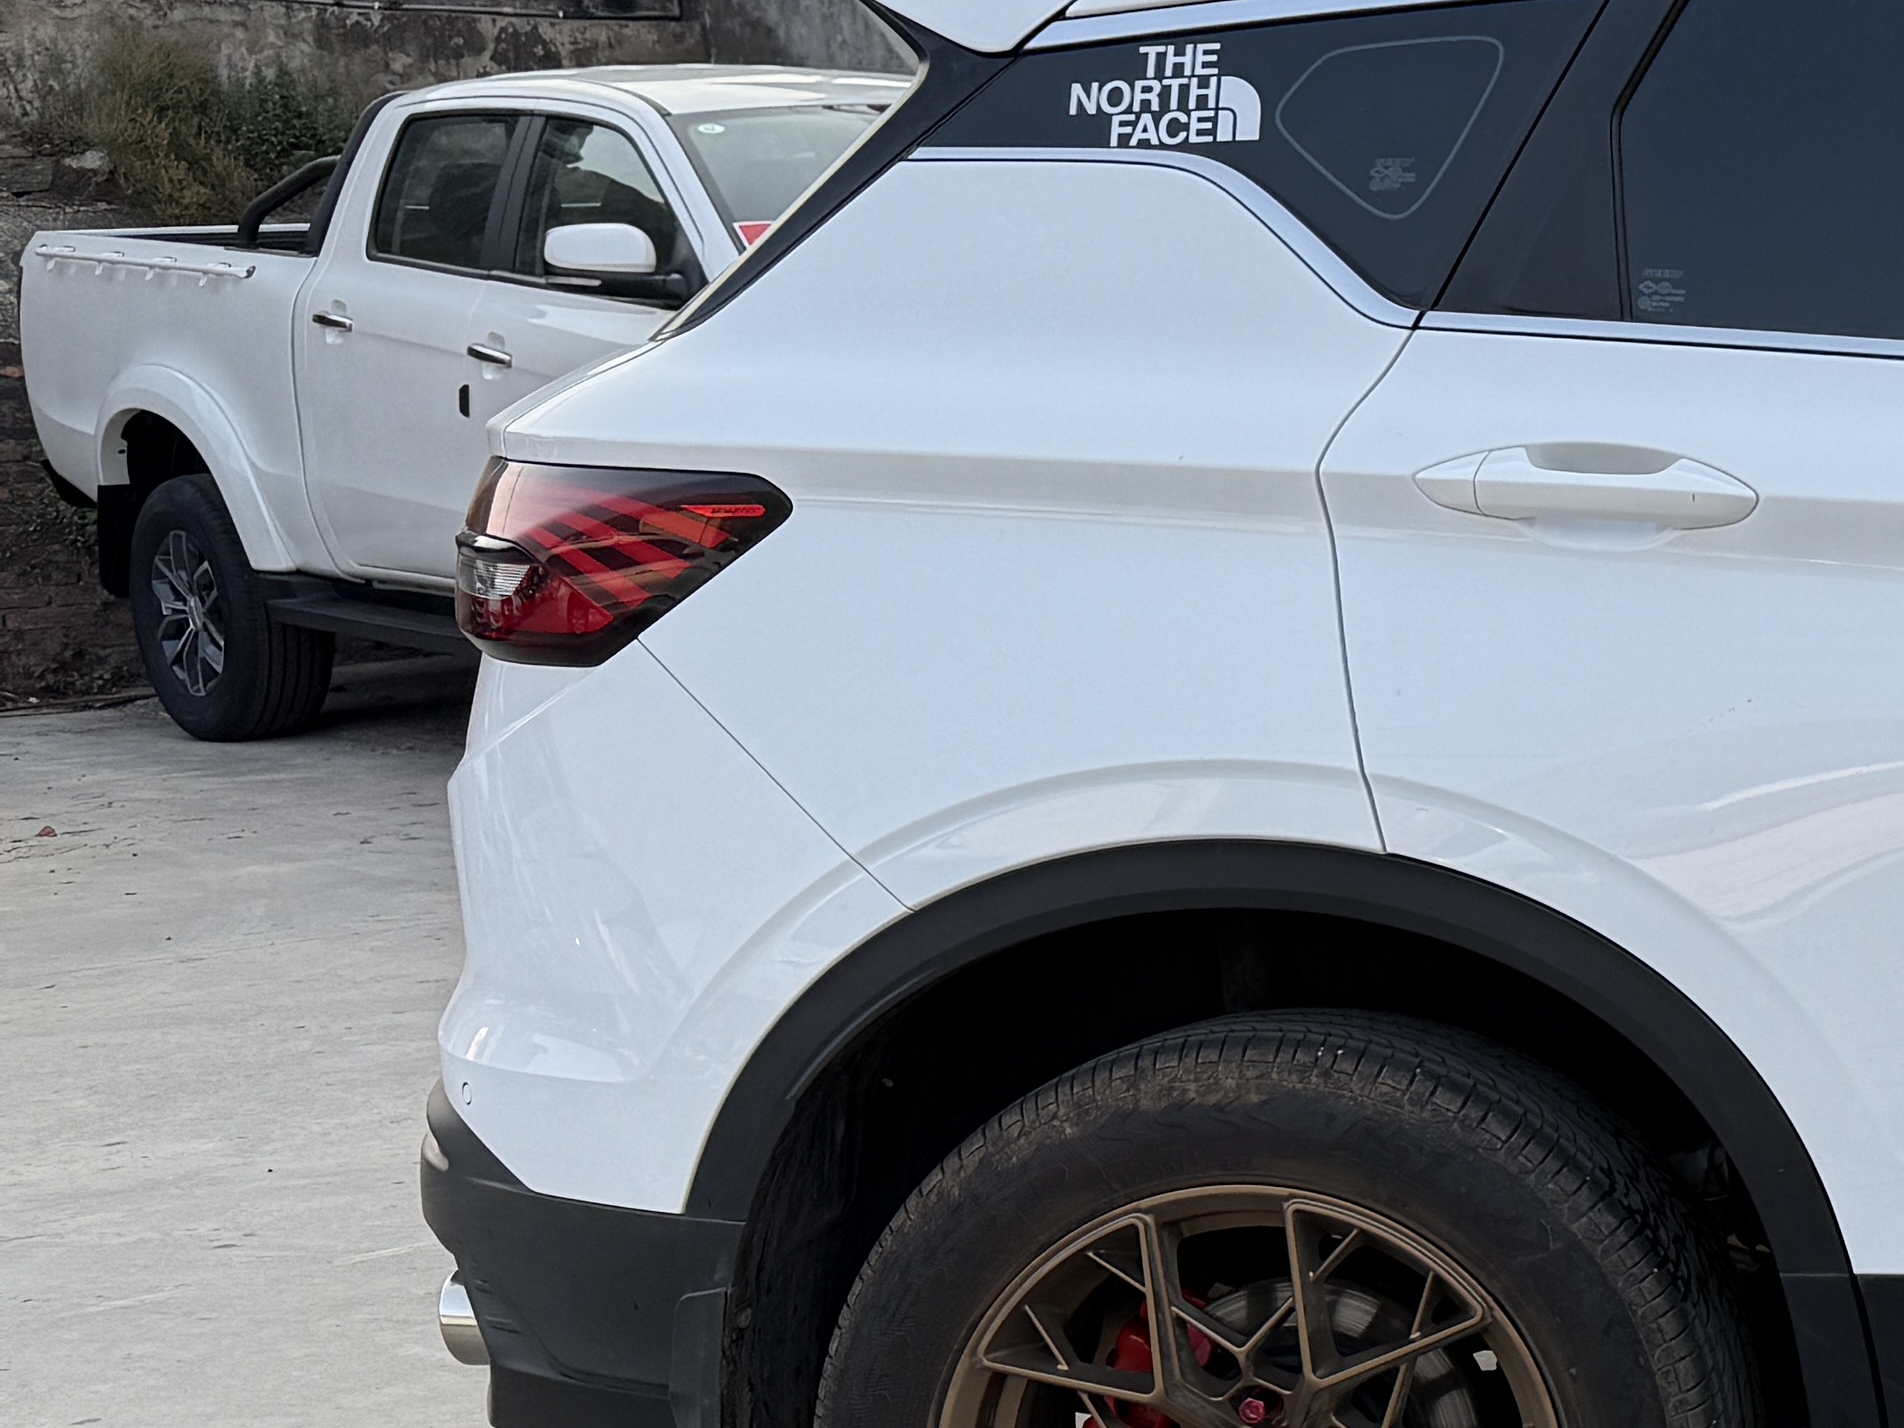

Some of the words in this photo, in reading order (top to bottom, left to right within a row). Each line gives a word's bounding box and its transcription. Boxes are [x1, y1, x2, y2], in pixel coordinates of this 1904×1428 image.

[1139, 42, 1221, 78] THE
[1069, 76, 1220, 116] NORTH
[1109, 110, 1216, 147] FACE
